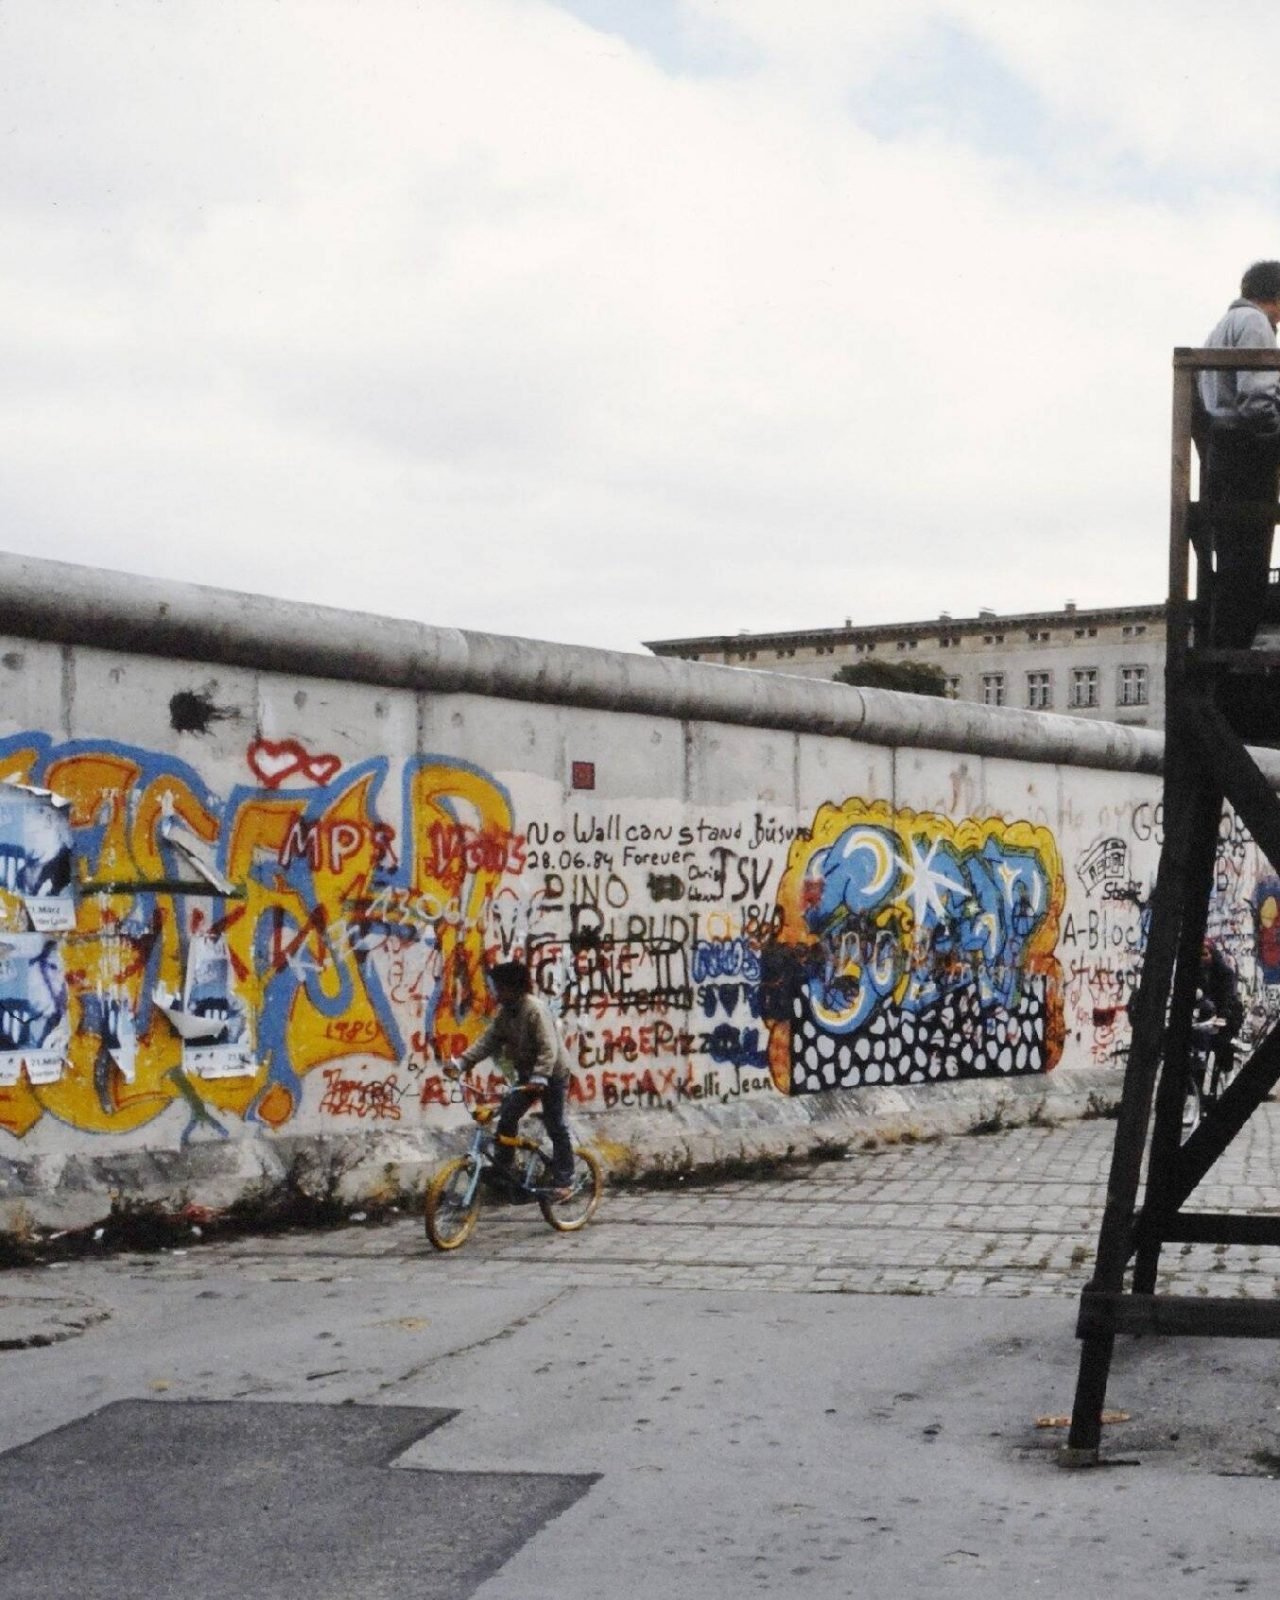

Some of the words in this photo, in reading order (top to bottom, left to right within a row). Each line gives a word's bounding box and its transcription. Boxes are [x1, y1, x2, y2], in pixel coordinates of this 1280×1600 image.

[527, 821, 565, 845] No
[573, 813, 621, 844] Wall
[625, 823, 673, 841] can
[678, 817, 743, 846] stand
[527, 850, 614, 872] 28.06.84
[622, 845, 697, 867] Forever
[709, 846, 773, 901] TSV
